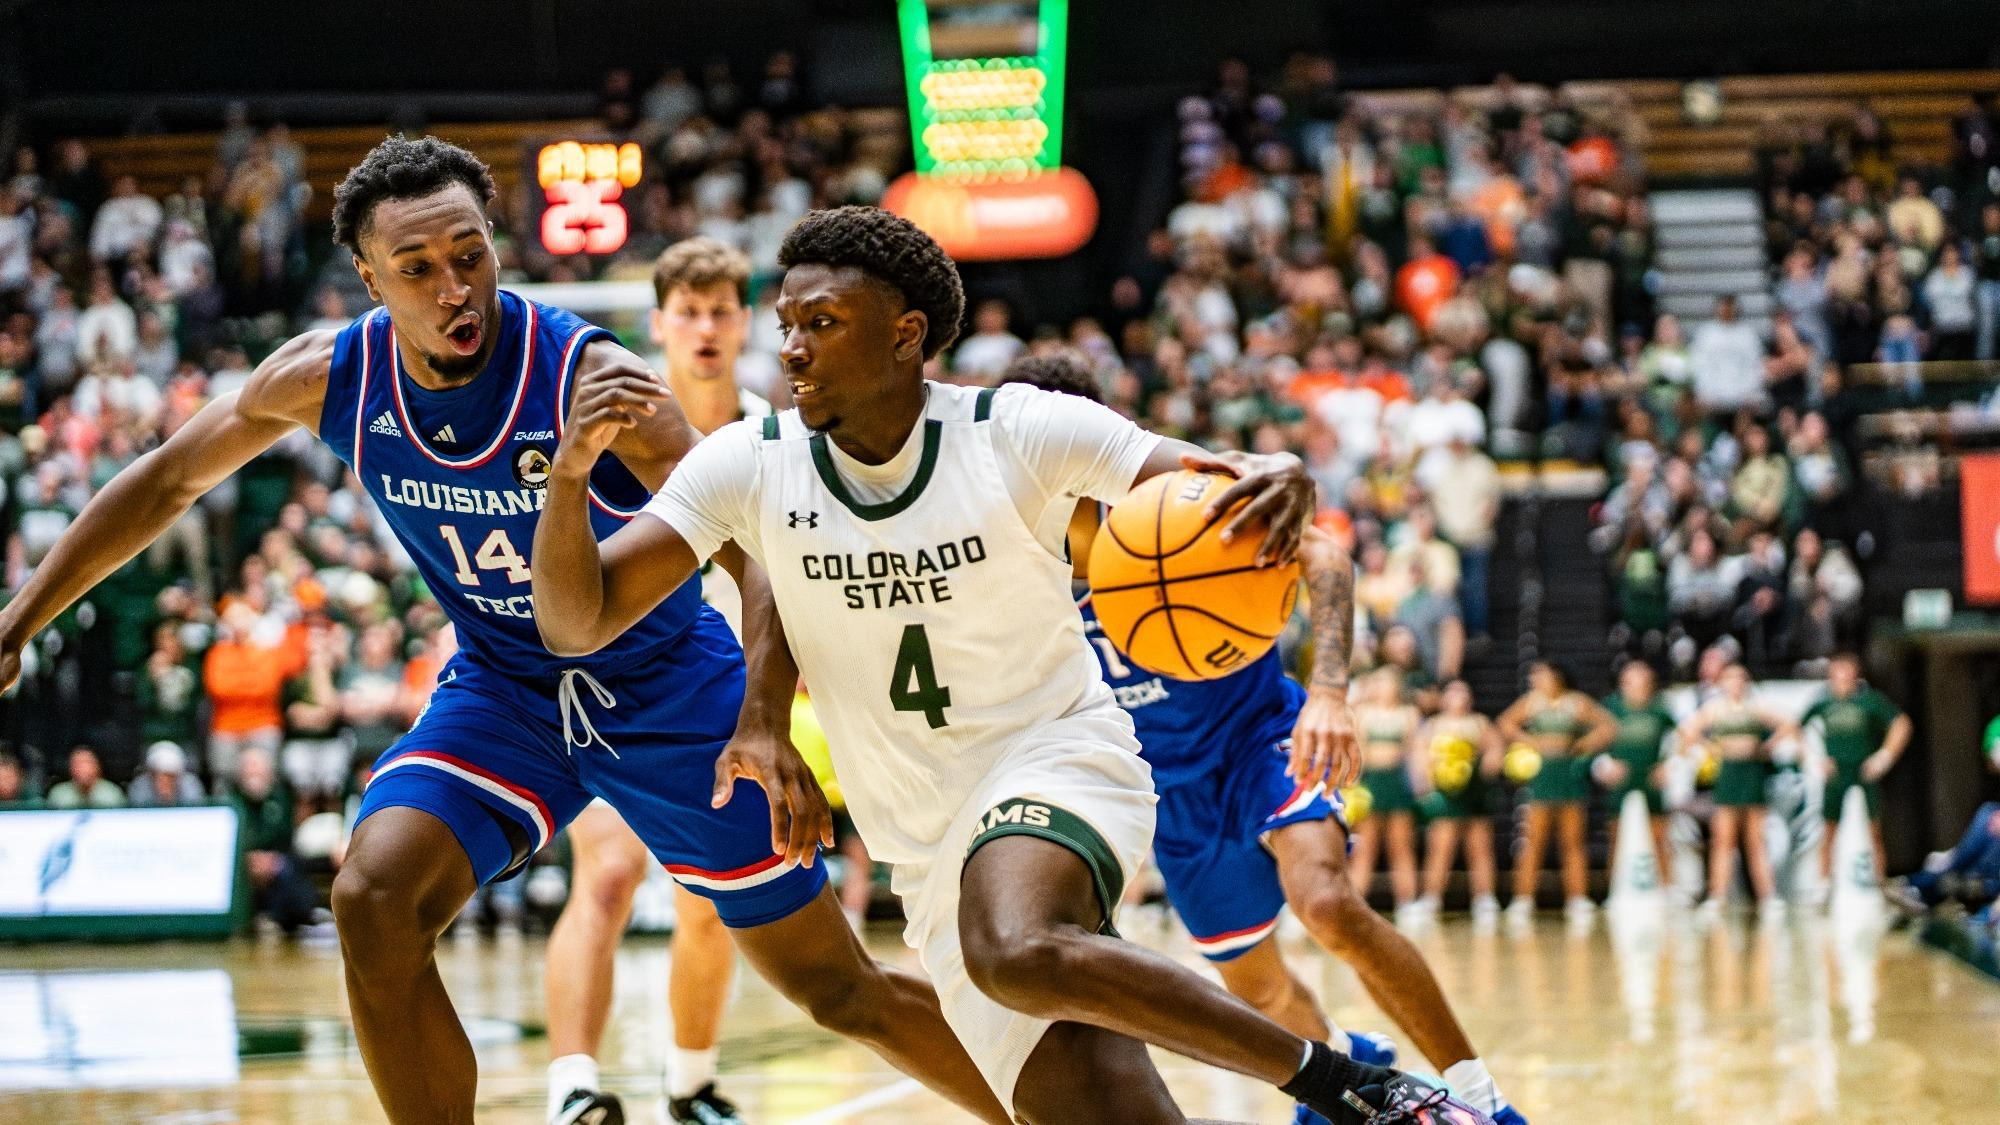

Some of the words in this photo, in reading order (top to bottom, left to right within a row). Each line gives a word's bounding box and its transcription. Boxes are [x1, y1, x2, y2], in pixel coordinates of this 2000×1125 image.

[369, 424, 402, 438] adidas
[438, 524, 533, 586] 14
[802, 535, 987, 581] COLORADO
[843, 575, 953, 609] STATE
[889, 623, 952, 730] 4
[970, 804, 1052, 842] AMS
